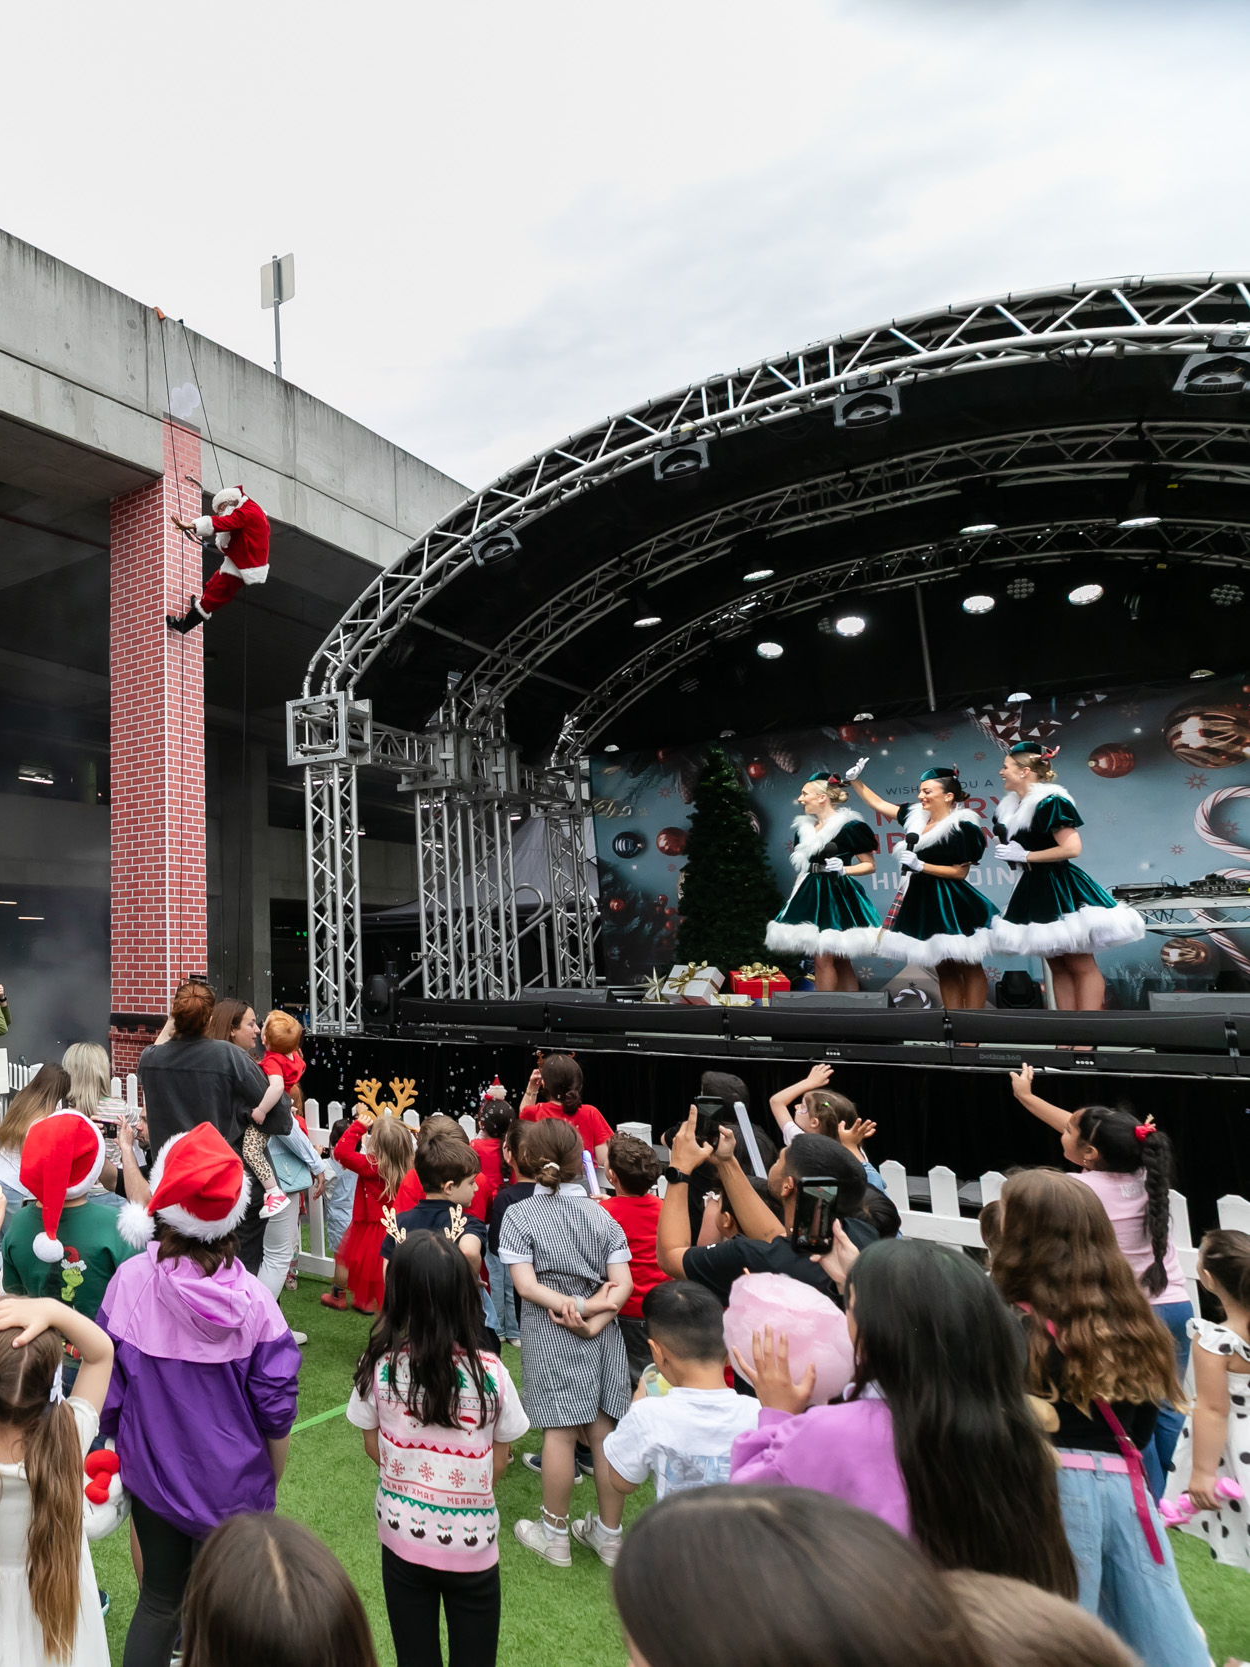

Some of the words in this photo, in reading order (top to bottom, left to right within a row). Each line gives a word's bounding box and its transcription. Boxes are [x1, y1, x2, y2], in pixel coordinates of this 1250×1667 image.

[984, 779, 994, 787] A
[383, 1480, 409, 1492] MERRY
[411, 1486, 435, 1502] XMAS
[447, 1496, 478, 1505] MERRY
